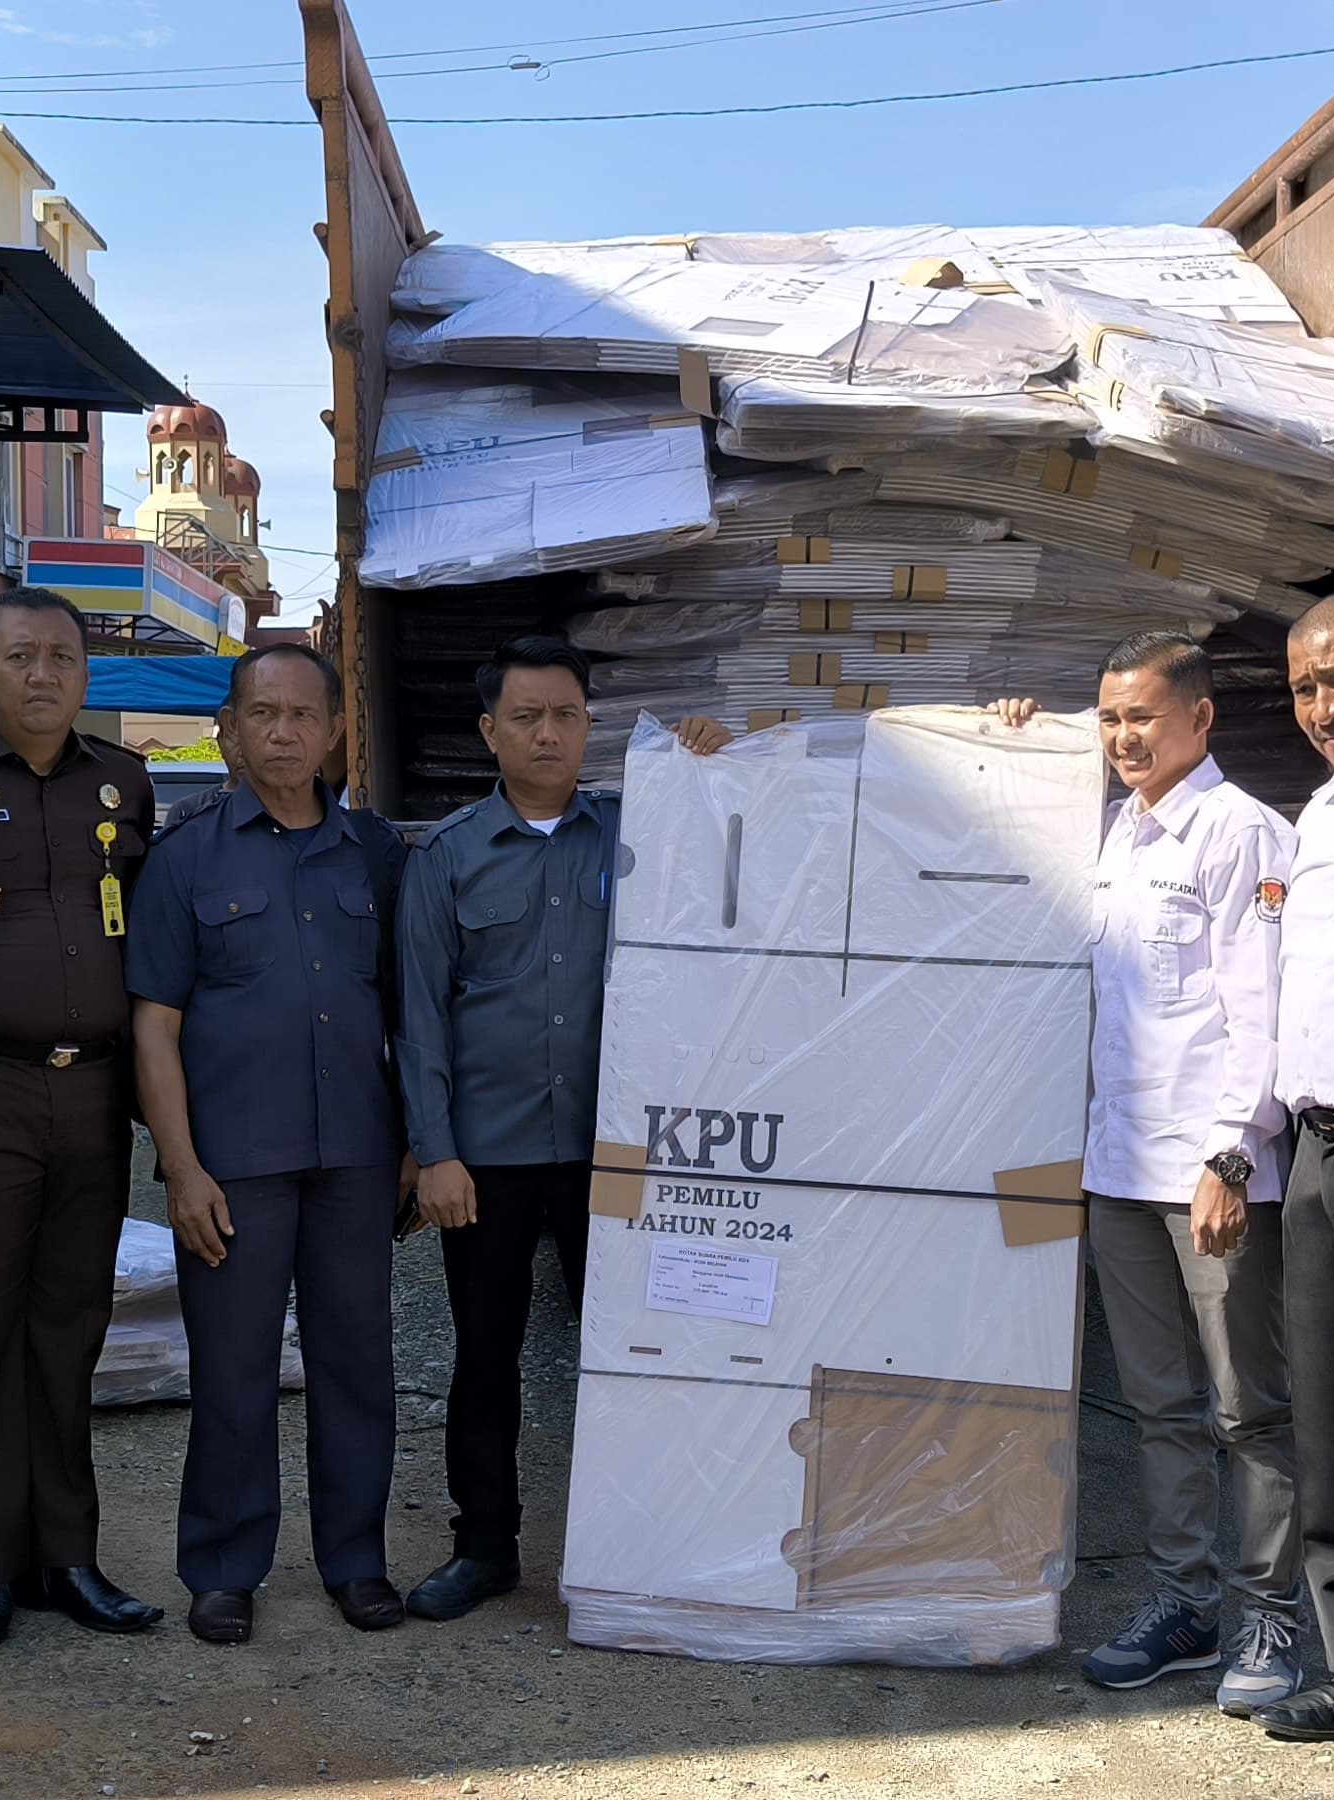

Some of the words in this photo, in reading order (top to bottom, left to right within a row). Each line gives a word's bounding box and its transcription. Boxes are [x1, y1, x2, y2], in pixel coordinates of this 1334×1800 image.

[644, 1105, 784, 1173] KPU
[656, 1184, 761, 1210] PEMILU
[726, 1219, 793, 1242] 2024
